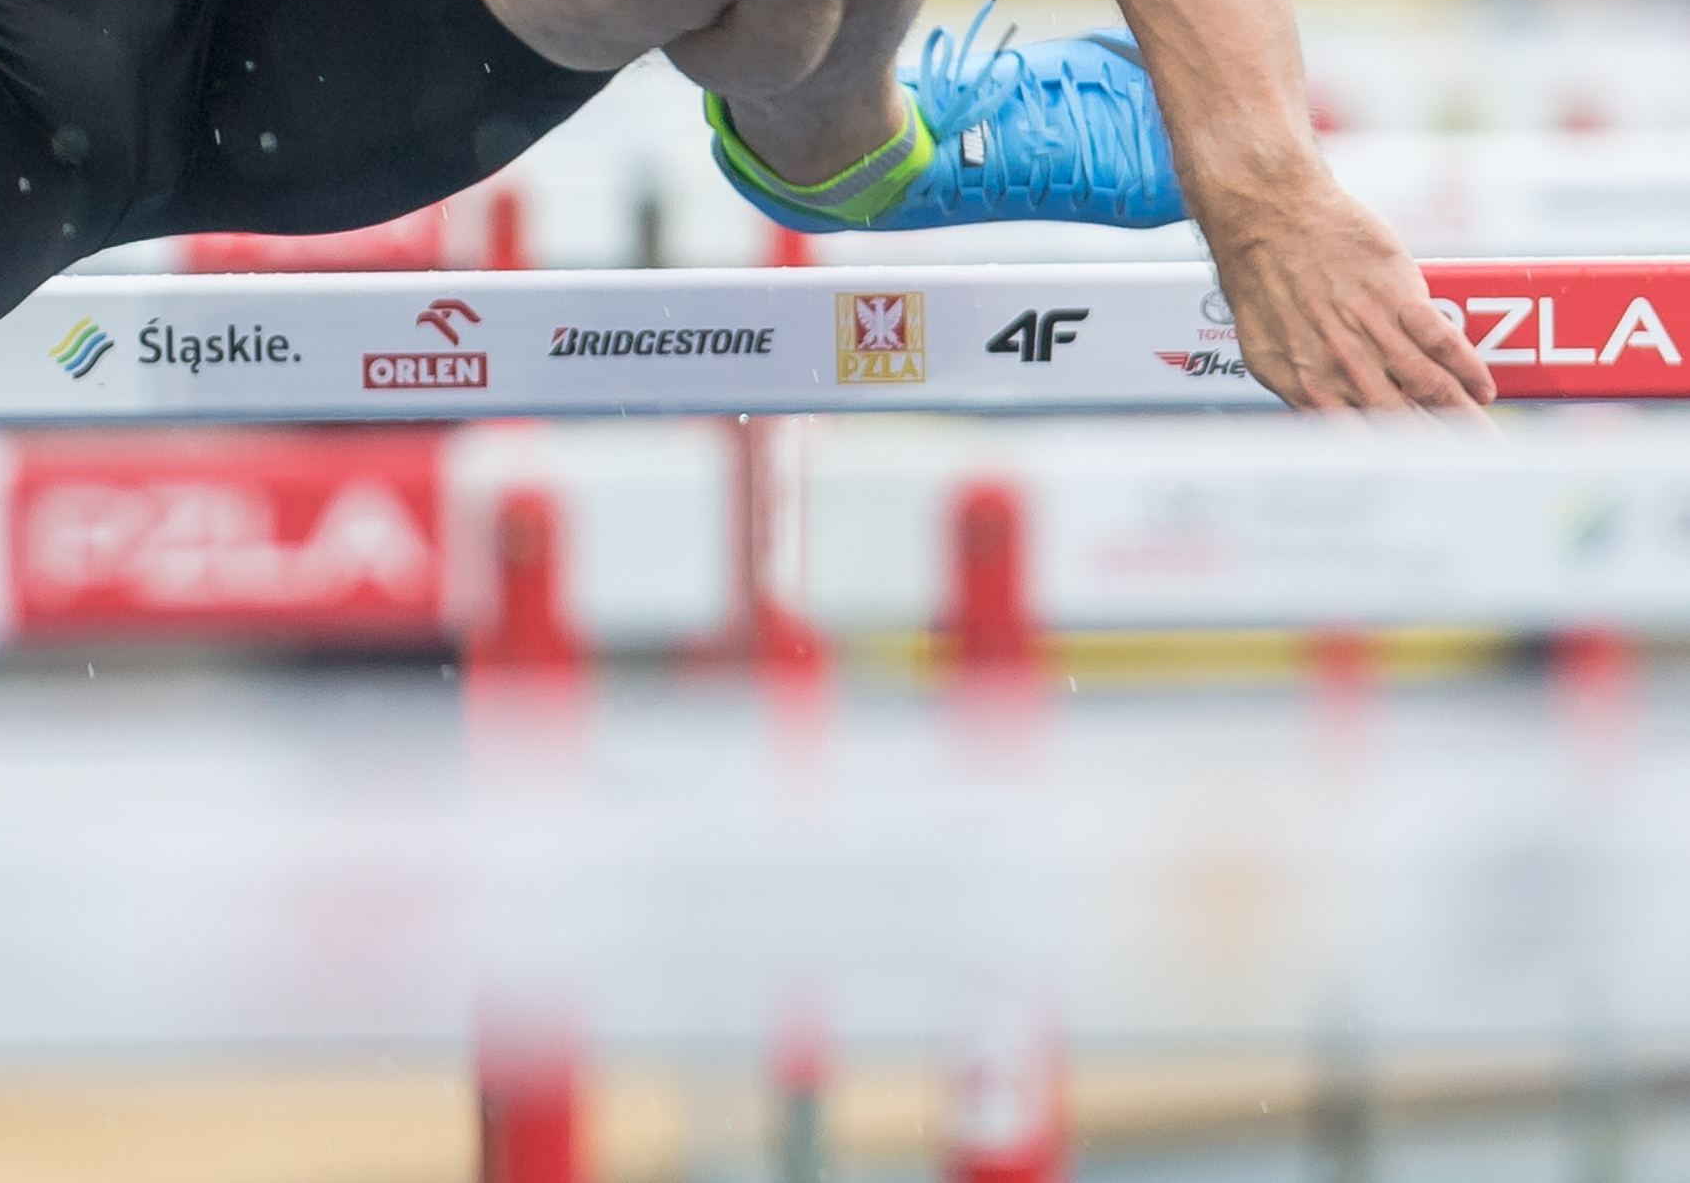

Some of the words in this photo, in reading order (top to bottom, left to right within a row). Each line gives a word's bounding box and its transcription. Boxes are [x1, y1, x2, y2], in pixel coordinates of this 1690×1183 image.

[548, 327, 775, 356] BRIDGESTONE
[985, 307, 1090, 363] 4F
[1197, 328, 1237, 341] TOYO
[1433, 296, 1683, 365] ZLA
[138, 318, 302, 375] Śląskie.
[368, 356, 481, 386] ORLEN
[841, 352, 919, 379] PZLA
